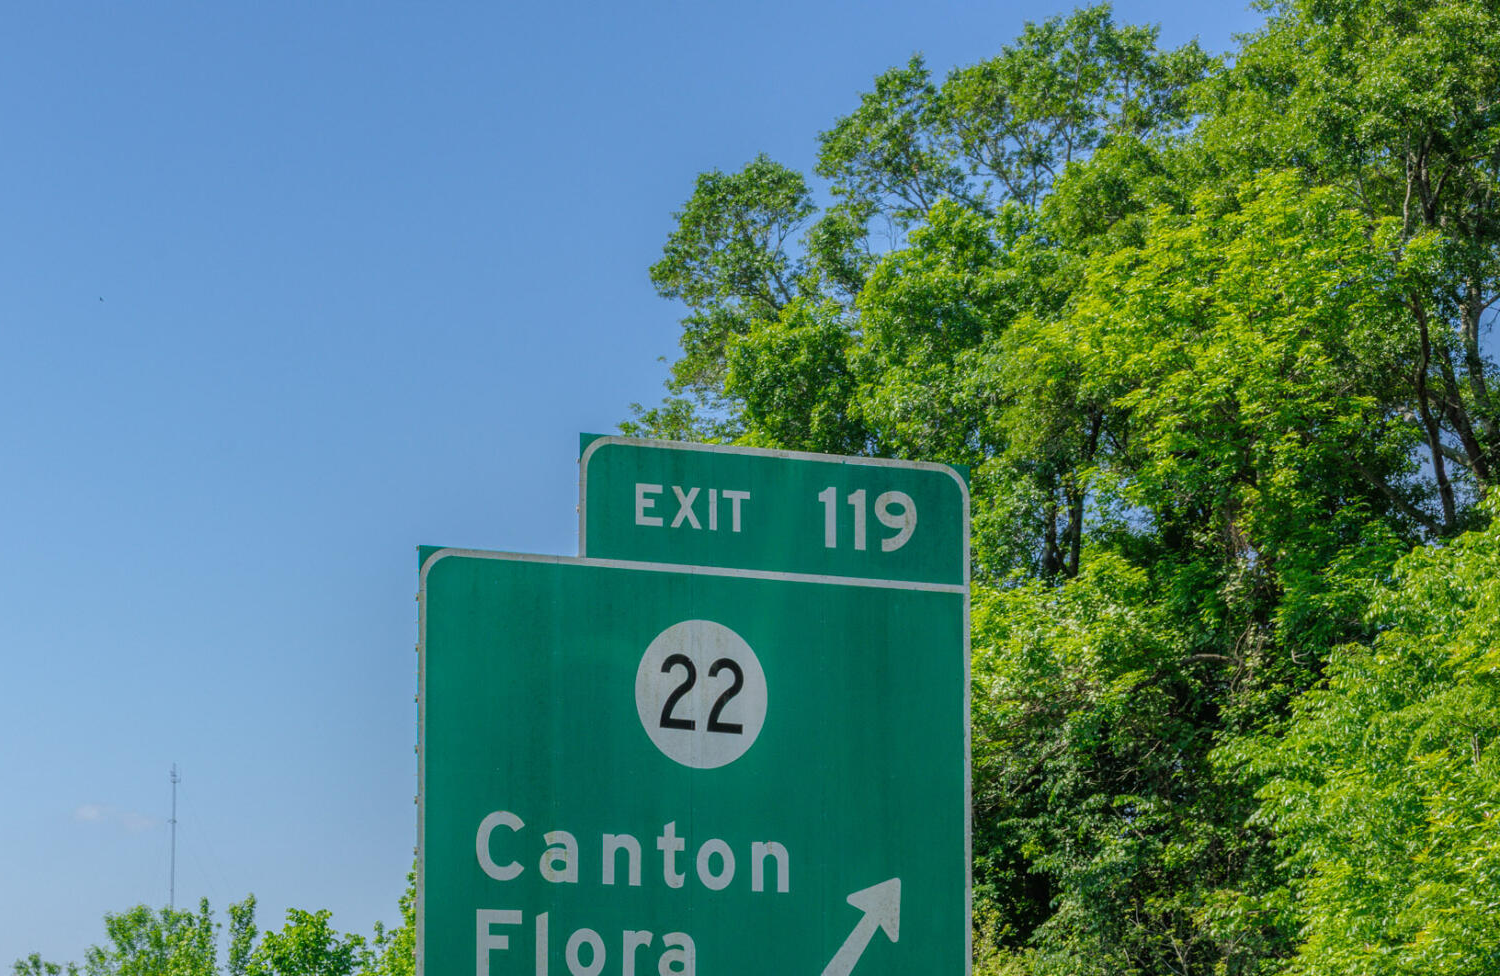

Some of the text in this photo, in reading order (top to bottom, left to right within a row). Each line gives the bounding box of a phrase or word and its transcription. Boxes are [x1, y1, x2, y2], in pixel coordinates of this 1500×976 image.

[634, 482, 918, 552] EXIT 119
[659, 652, 745, 735] 22
[475, 809, 790, 894] Canton
